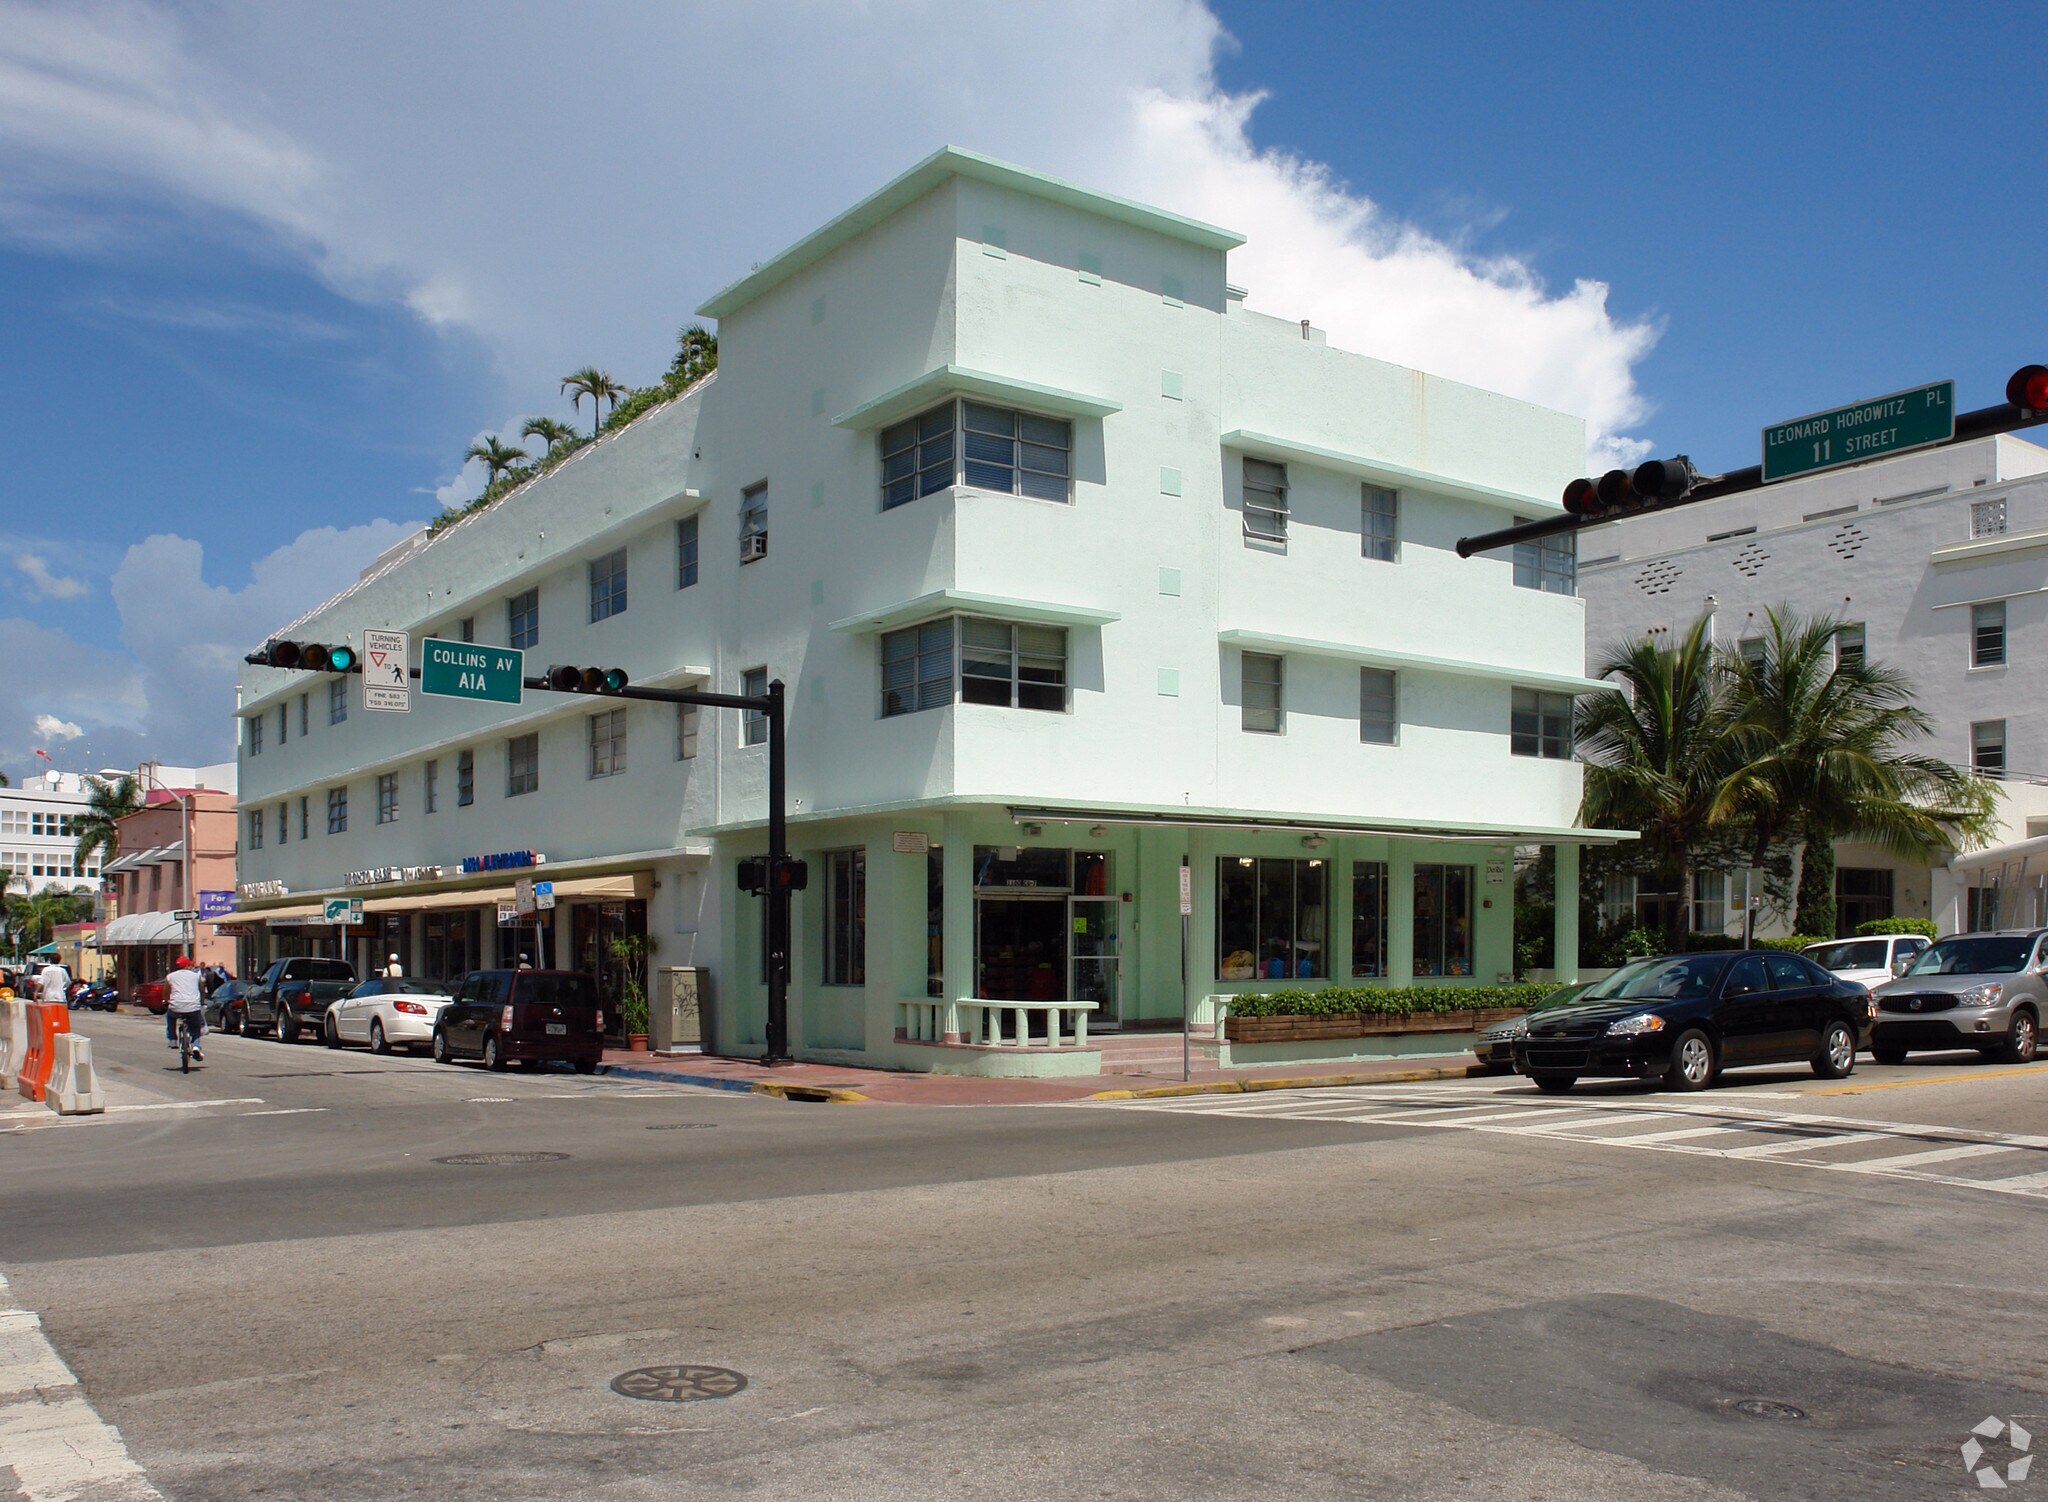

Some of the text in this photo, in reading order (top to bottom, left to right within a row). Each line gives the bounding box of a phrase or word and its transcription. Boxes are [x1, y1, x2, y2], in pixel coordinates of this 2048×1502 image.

[1769, 390, 1945, 446] LEONARD HOROWITZ PL
[1813, 428, 1898, 463] 11 STREET
[371, 634, 401, 644] TURNING
[370, 642, 403, 652] VEHICLES
[433, 649, 513, 671] COLLINS AV
[458, 672, 487, 691] A1A
[211, 894, 227, 902] For
[204, 903, 233, 911] Lease
